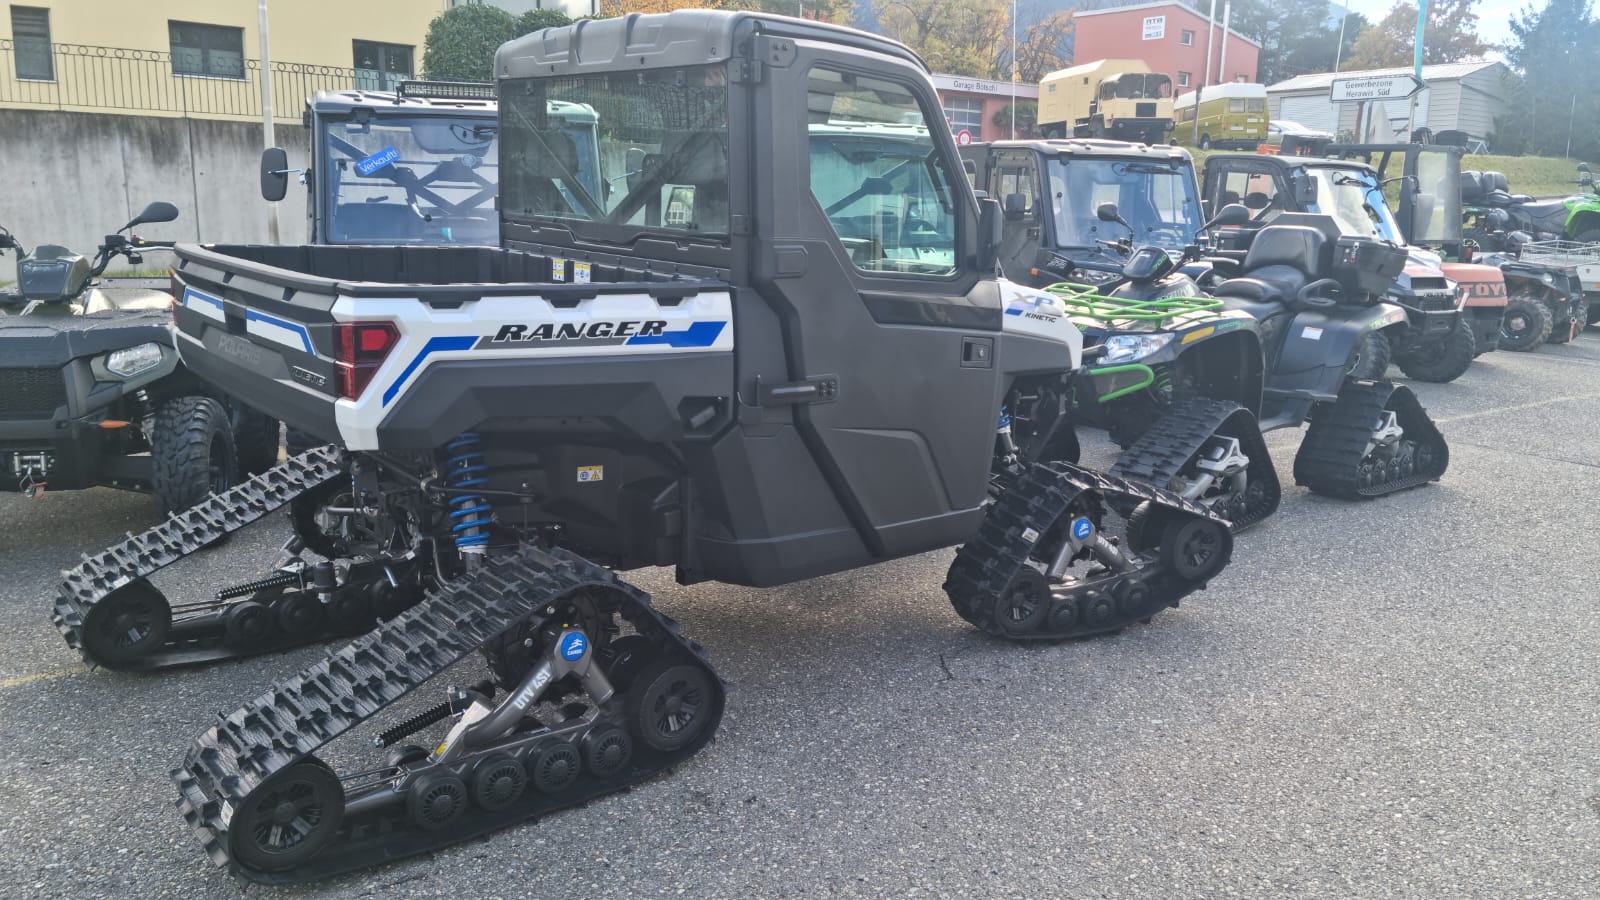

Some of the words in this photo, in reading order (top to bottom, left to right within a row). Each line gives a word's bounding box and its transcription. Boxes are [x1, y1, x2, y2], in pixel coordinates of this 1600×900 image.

[953, 80, 975, 91] Garage
[1345, 80, 1393, 89] Gewerbezone
[1377, 88, 1391, 96] Süd
[1009, 291, 1056, 308] XP
[1024, 312, 1057, 324] KINETIC
[492, 320, 668, 342] RANGER
[513, 686, 535, 710] UTV
